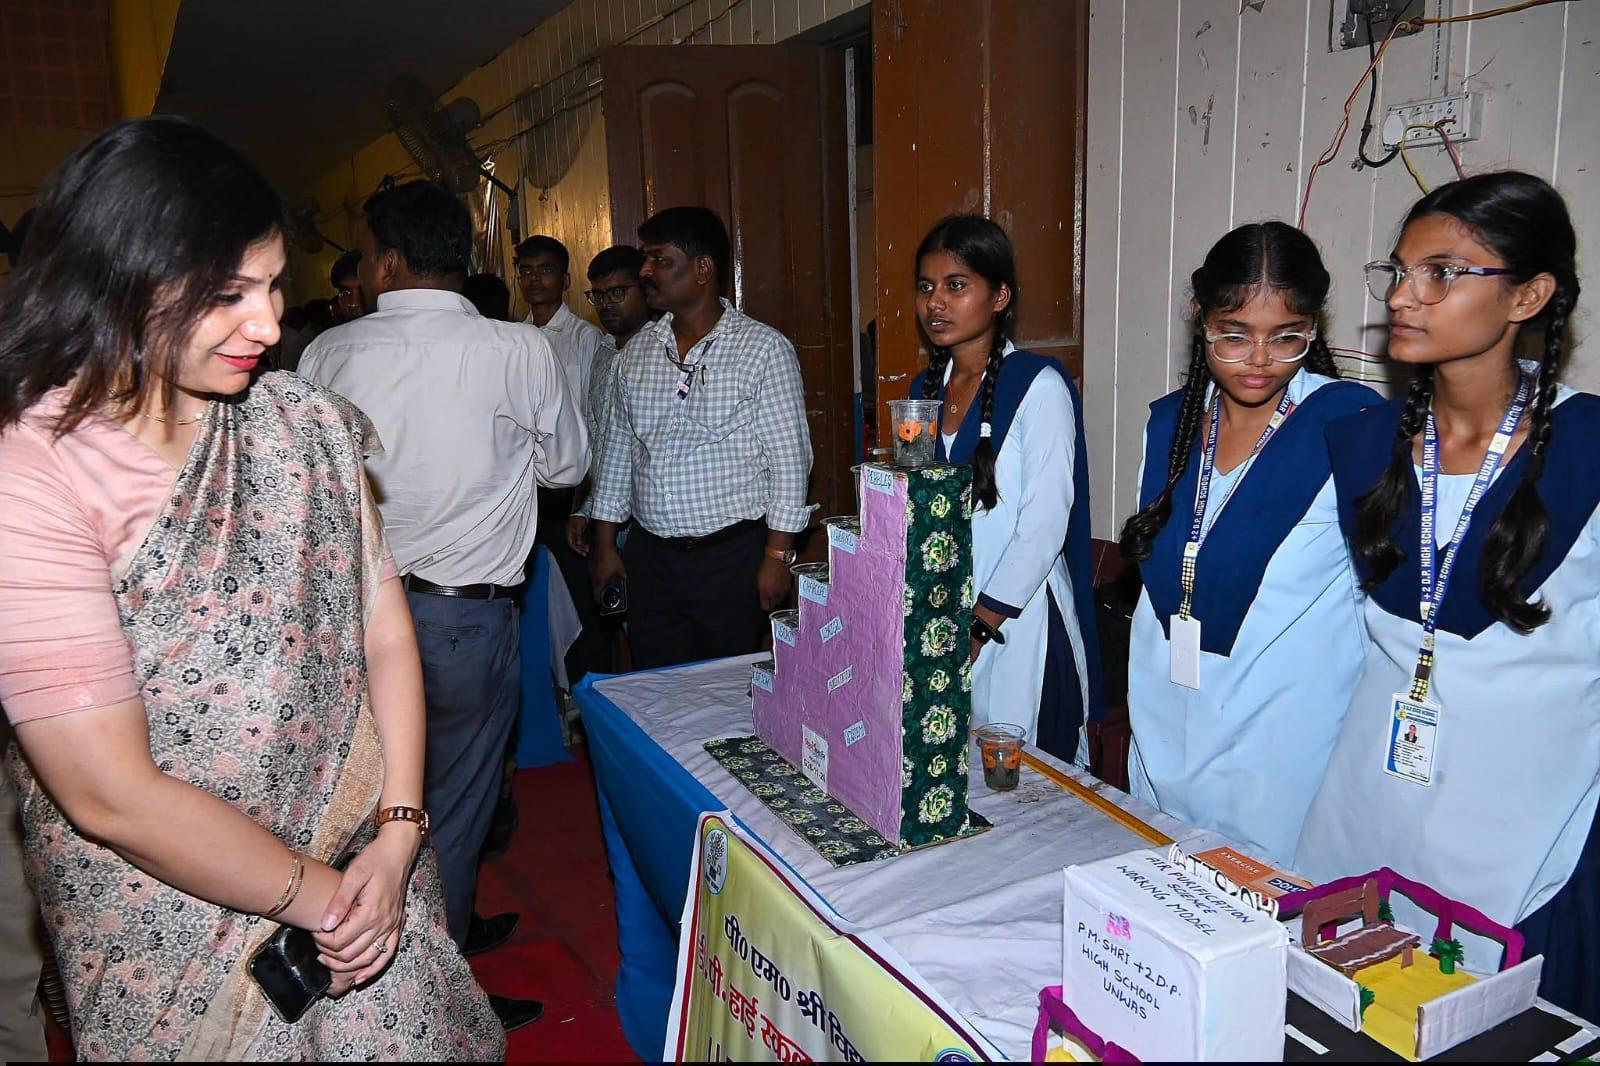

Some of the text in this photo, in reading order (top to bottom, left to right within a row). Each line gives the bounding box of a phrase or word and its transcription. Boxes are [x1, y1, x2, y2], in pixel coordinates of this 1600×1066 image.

[1500, 406, 1523, 432] BUXAR
[1204, 445, 1215, 470] UNWAS,
[1424, 442, 1437, 472] ITARHI,
[1199, 472, 1211, 499] SCHOOL,
[1423, 474, 1436, 507] UNWAS,
[1196, 500, 1206, 516] HIGH
[1191, 530, 1199, 540] +2
[1421, 509, 1434, 545] SCHOOL,
[1433, 580, 1446, 601] HIGH
[1464, 484, 1487, 512] ITARHI,
[1477, 454, 1499, 481] BUXAR
[1421, 547, 1432, 567] HIGH
[1423, 587, 1432, 600] +2
[1115, 865, 1166, 902] WORKING
[1165, 902, 1218, 937] MODEL
[1144, 855, 1173, 875] AIR
[1168, 869, 1255, 925] PURIFICATION
[1166, 882, 1218, 915] SCIENCE
[1102, 938, 1132, 965] SHRI
[1082, 943, 1161, 1011] HIGH SCHOOL
[1102, 976, 1148, 1021] UNWAS
